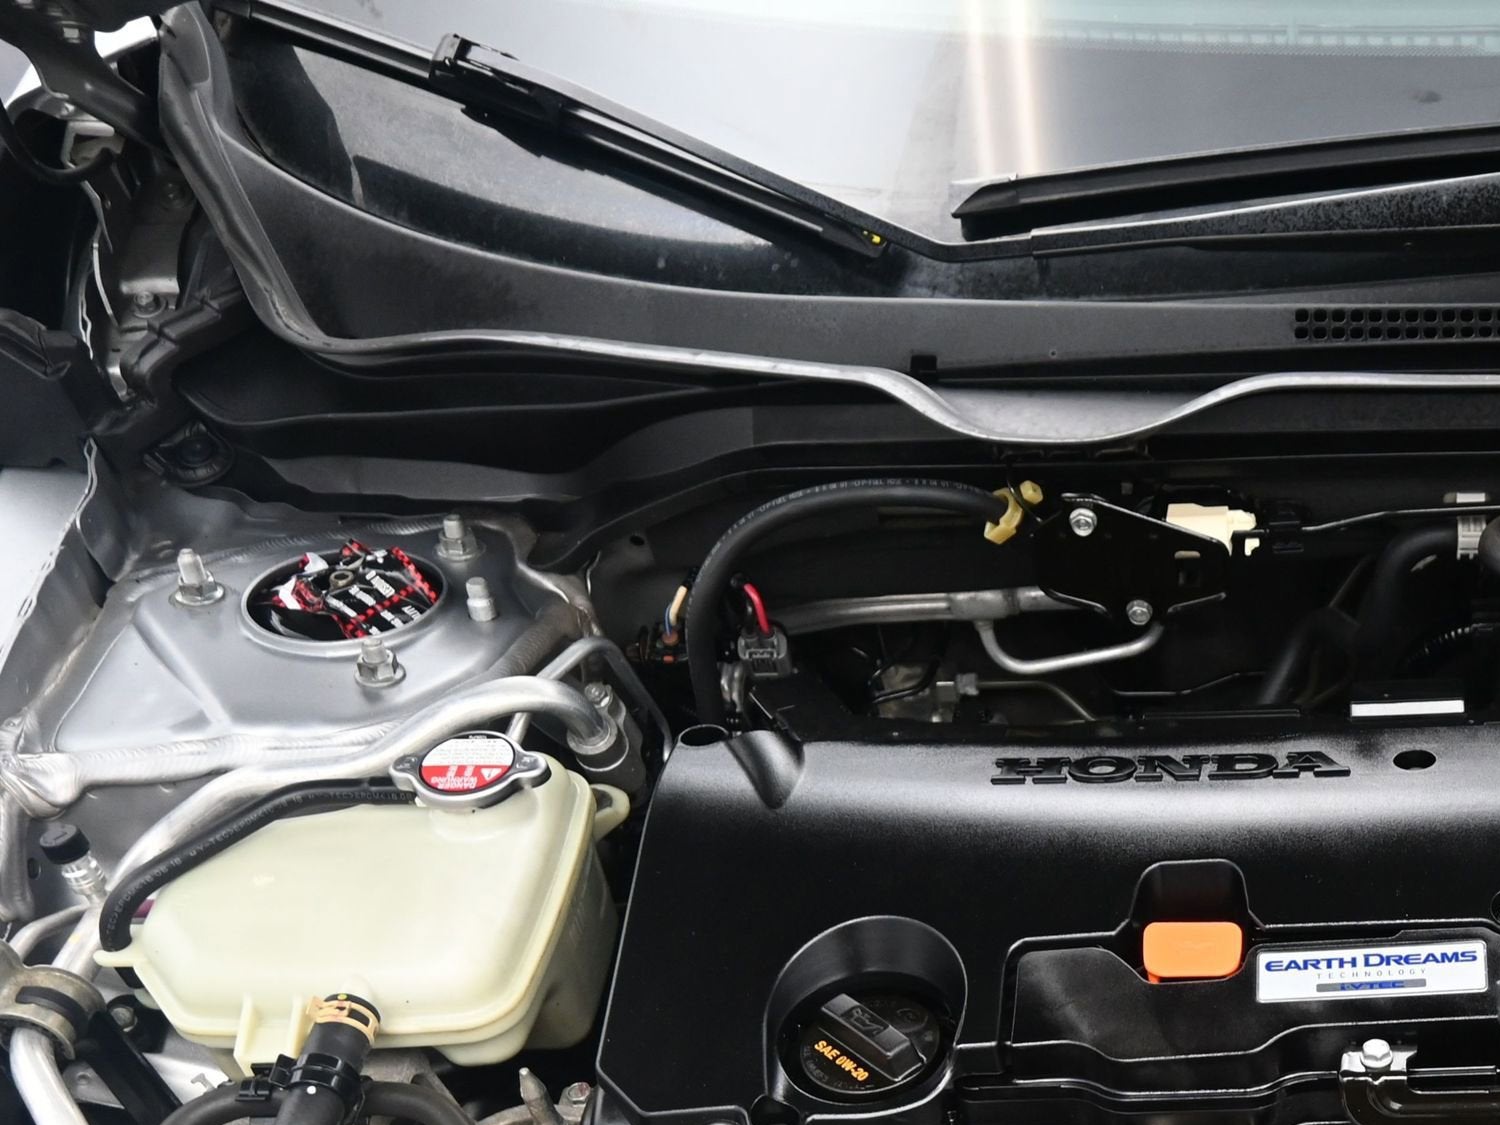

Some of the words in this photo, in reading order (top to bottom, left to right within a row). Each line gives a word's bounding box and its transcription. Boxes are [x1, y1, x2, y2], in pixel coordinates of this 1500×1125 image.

[990, 751, 1351, 785] HONDA
[1264, 956, 1357, 972] EARTH
[1363, 950, 1478, 968] DREAMS
[1316, 969, 1427, 979] TECHNOLOGY
[814, 1040, 841, 1060] SAE
[835, 1054, 869, 1082] 0W-20
